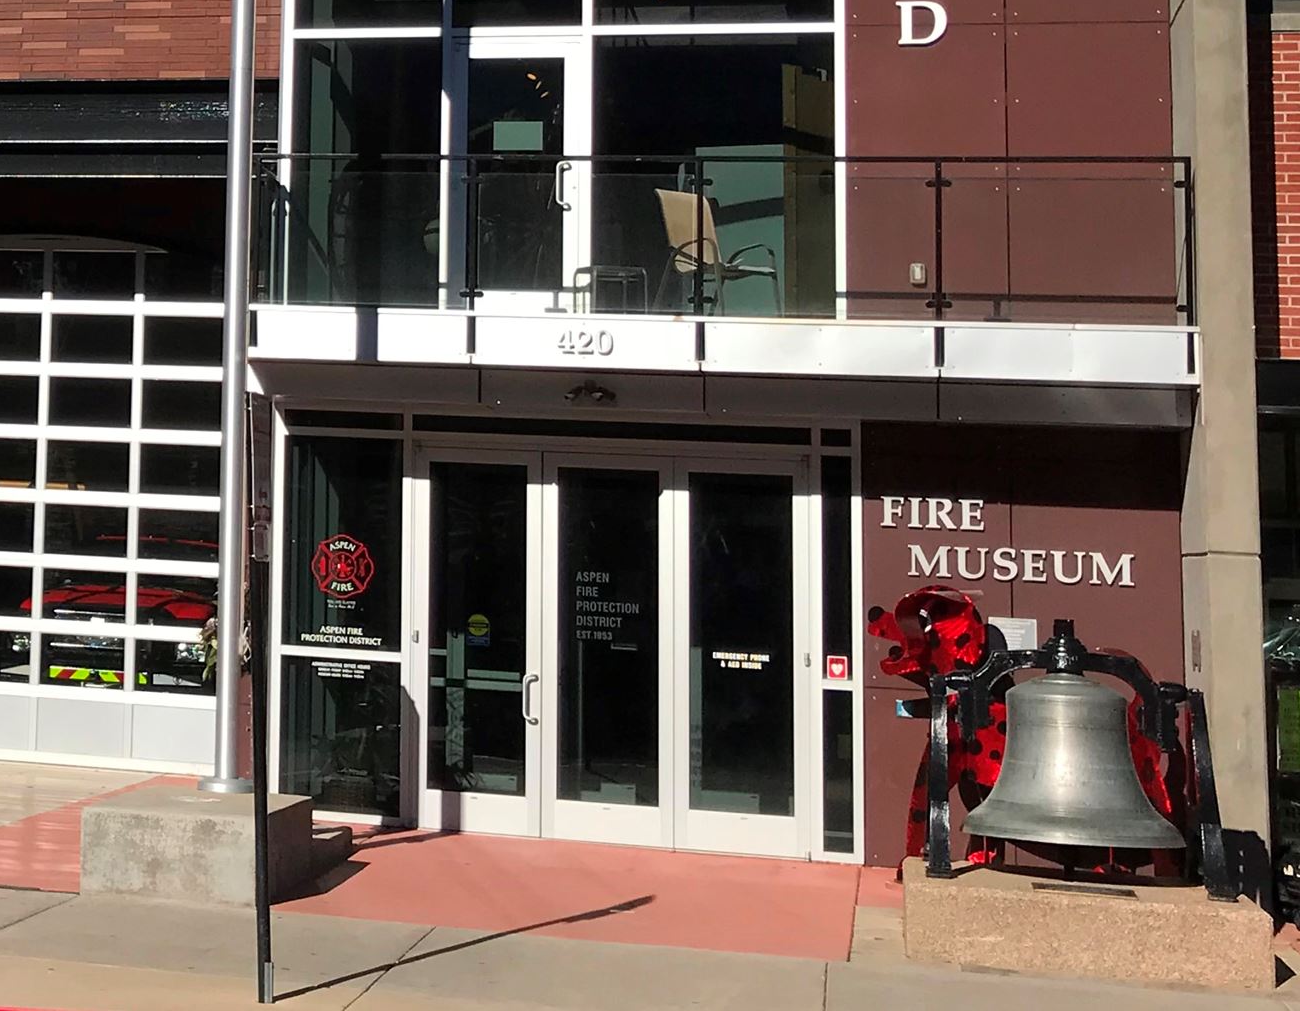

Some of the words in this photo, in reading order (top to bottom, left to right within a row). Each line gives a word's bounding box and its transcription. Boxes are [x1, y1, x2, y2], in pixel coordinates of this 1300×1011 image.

[557, 330, 614, 356] 420
[880, 496, 985, 531] FIRE
[329, 541, 357, 552] ASPEN
[908, 544, 1135, 587] MUSEUM
[575, 571, 610, 583] ASPEN
[331, 581, 355, 592] FIRE
[576, 586, 599, 597] FIRE
[576, 600, 640, 614] PROTECTION
[576, 615, 623, 628] DISTRICT
[320, 625, 346, 635] ASPEN
[347, 626, 363, 636] FIRE
[301, 633, 348, 644] PROTECTION
[349, 636, 382, 646] DISTRICT
